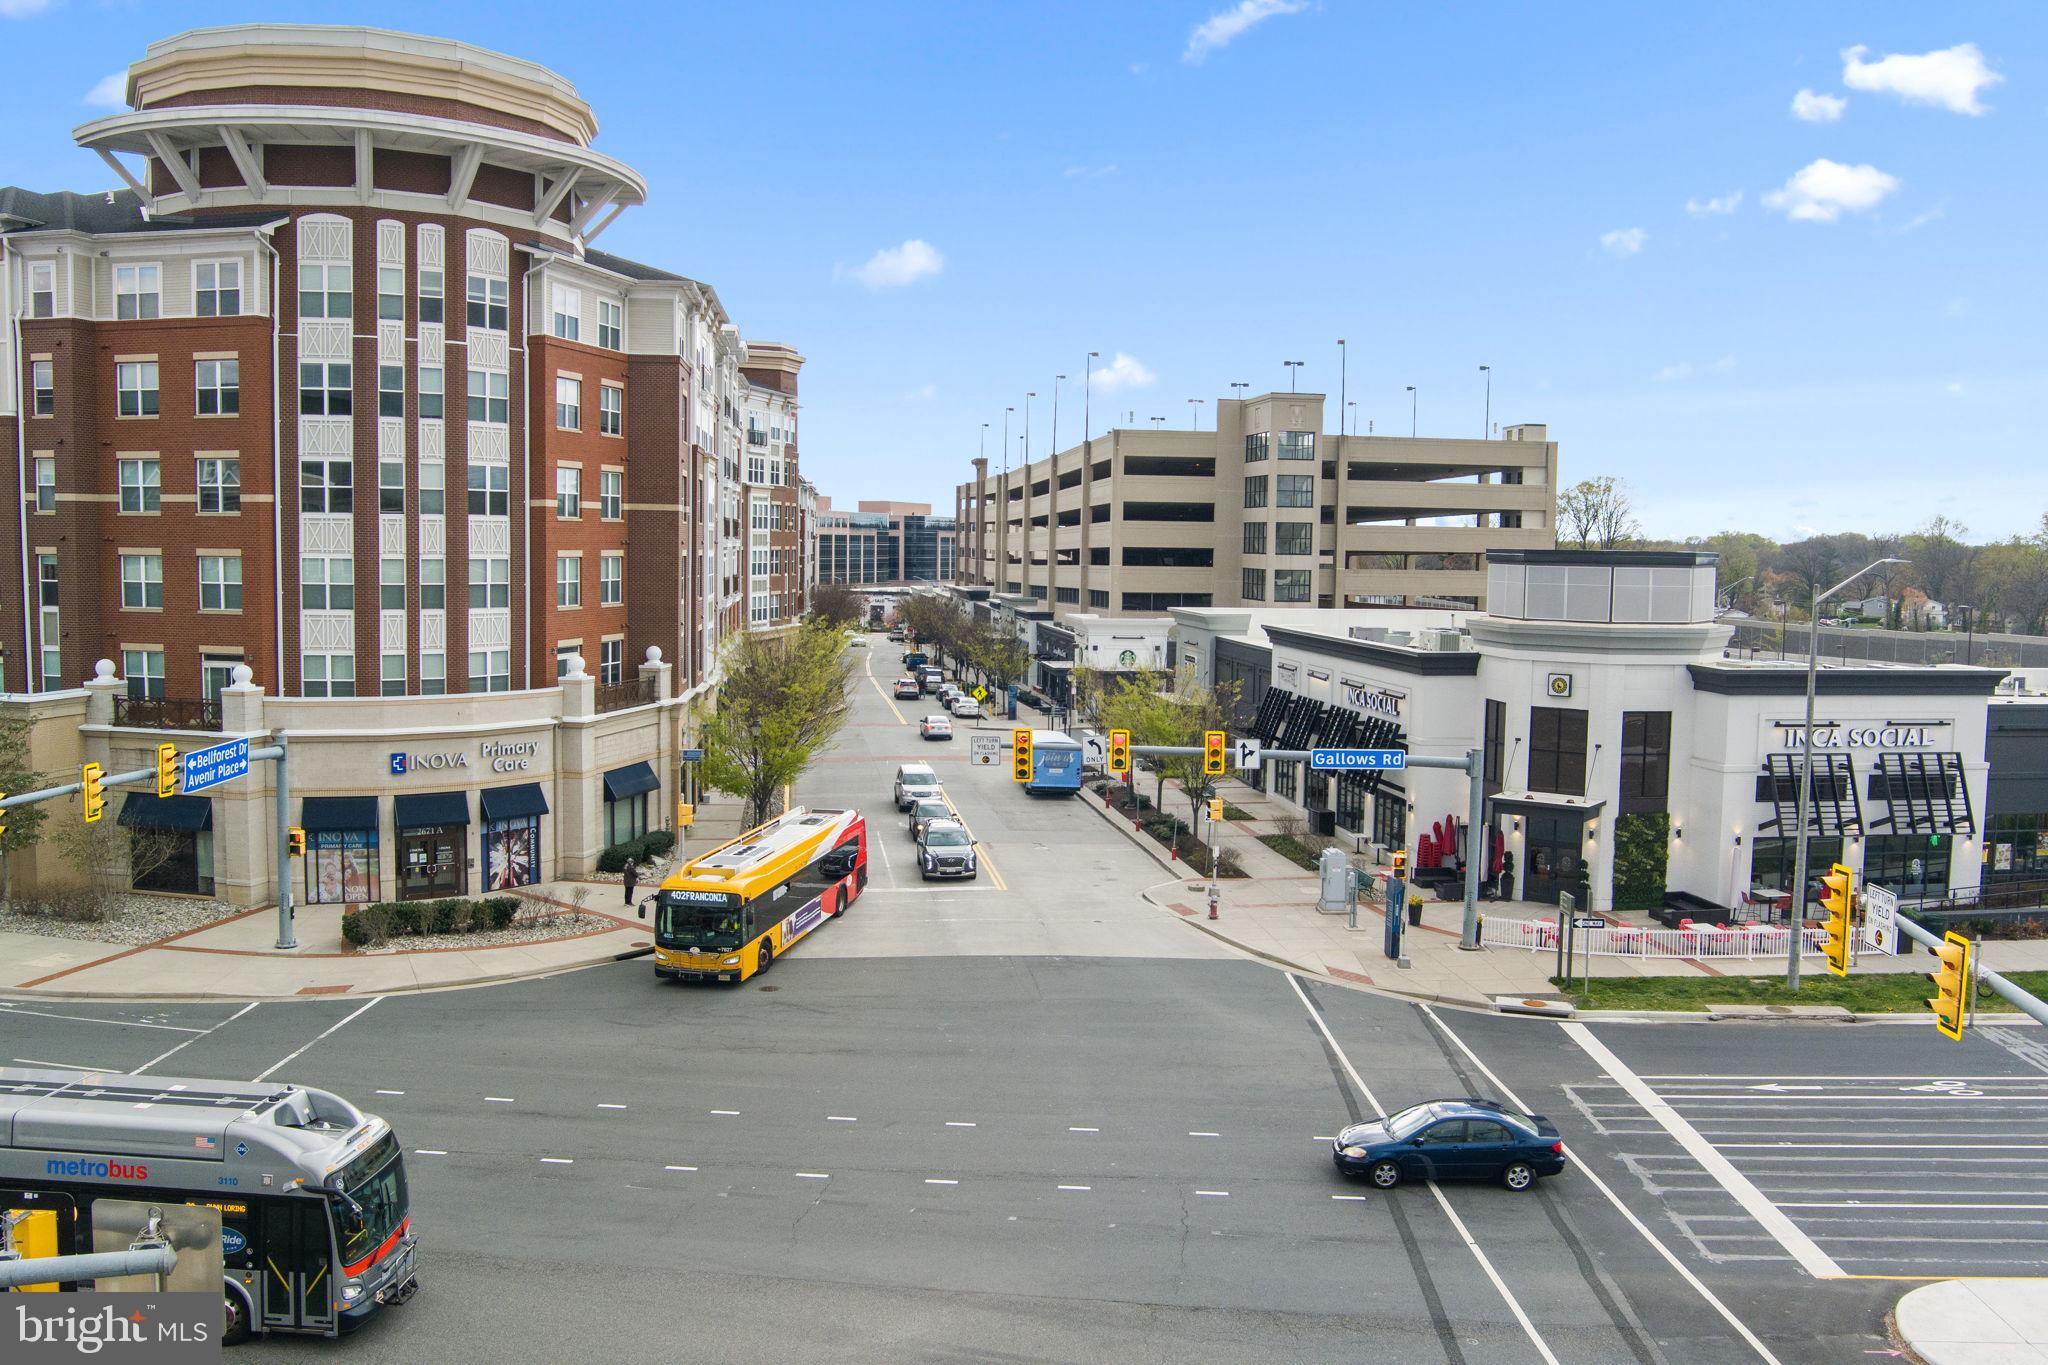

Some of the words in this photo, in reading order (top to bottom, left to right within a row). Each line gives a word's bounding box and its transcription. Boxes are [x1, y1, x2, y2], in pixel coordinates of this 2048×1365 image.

[1347, 687, 1366, 706] NCA
[1366, 693, 1399, 715] SOCIAL
[1785, 728, 1842, 747] INCA
[1848, 728, 1934, 747] SOCIAL
[197, 744, 237, 768] Bellforest
[239, 743, 248, 756] Dr
[481, 741, 540, 758] Primary
[1315, 752, 1376, 765] Gallows
[1382, 753, 1402, 765] Rd
[410, 752, 469, 770] INOVA
[492, 757, 529, 773] Care
[188, 767, 216, 788] Avenir
[218, 762, 239, 778] Place
[318, 831, 360, 842] INOVA
[436, 826, 443, 834] A
[529, 827, 537, 868] COMMUNITY
[345, 885, 367, 893] NOW
[1869, 888, 1881, 901] LEFT
[1881, 893, 1893, 907] TURN
[1872, 902, 1890, 920] YIELD
[47, 1158, 149, 1180] metrobus
[217, 1176, 239, 1186] 3110
